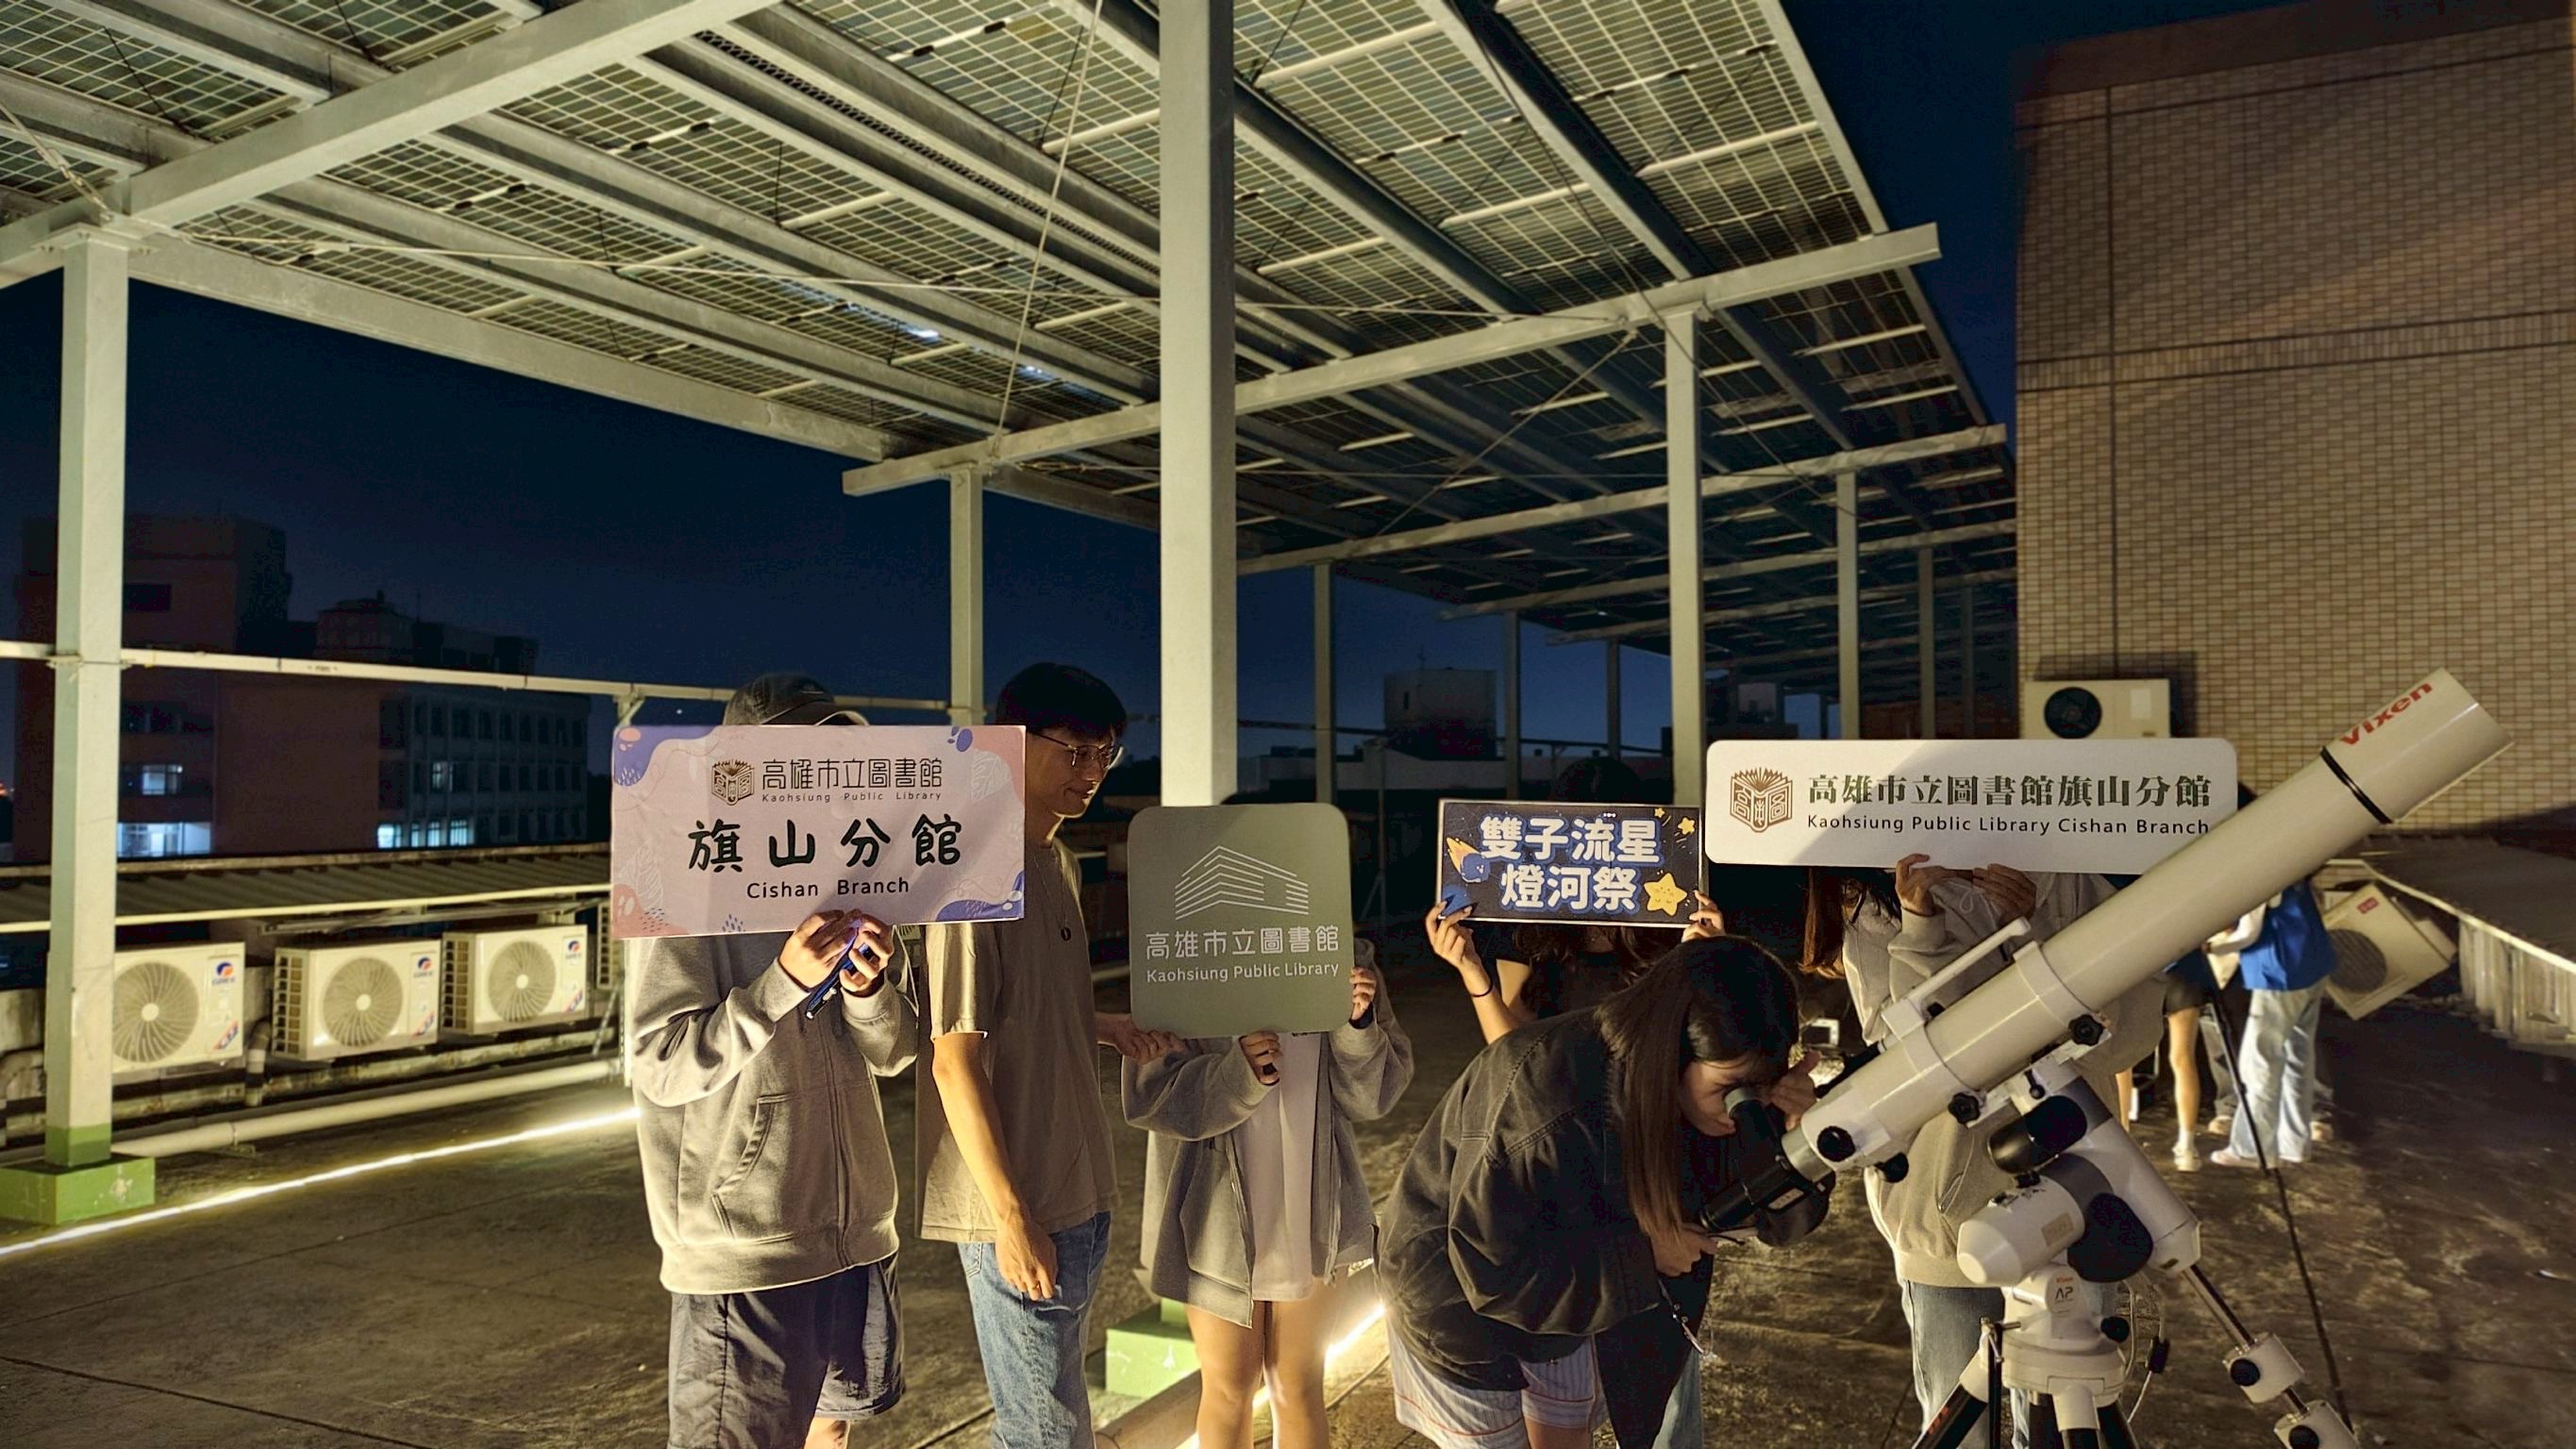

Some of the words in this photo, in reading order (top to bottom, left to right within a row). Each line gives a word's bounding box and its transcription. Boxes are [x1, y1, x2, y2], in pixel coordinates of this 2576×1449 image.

[2340, 683, 2433, 745] Vixen
[762, 758, 943, 790] 高雄市立圖書館
[1809, 774, 2212, 808] 高雄市立圖書館旗山分館
[761, 793, 831, 803] Kaohsiung
[844, 791, 884, 801] Public
[895, 791, 942, 801] Library
[1480, 815, 1660, 863] 雙子流星
[1808, 815, 1903, 833] Kaohsiung
[1912, 816, 1971, 831] Public
[1980, 817, 2050, 836] Library
[2058, 818, 2127, 833] Cishan
[2136, 819, 2209, 834] Branch
[688, 813, 963, 874] 旗山分館
[746, 882, 819, 899] Cishan
[837, 877, 910, 896] Branch
[1501, 864, 1637, 910] 燈河祭
[1146, 924, 1339, 959] 高雄市立圖書館
[1146, 967, 1228, 983] Kaohsiung
[1233, 963, 1280, 978] Public
[1284, 961, 1339, 977] Library
